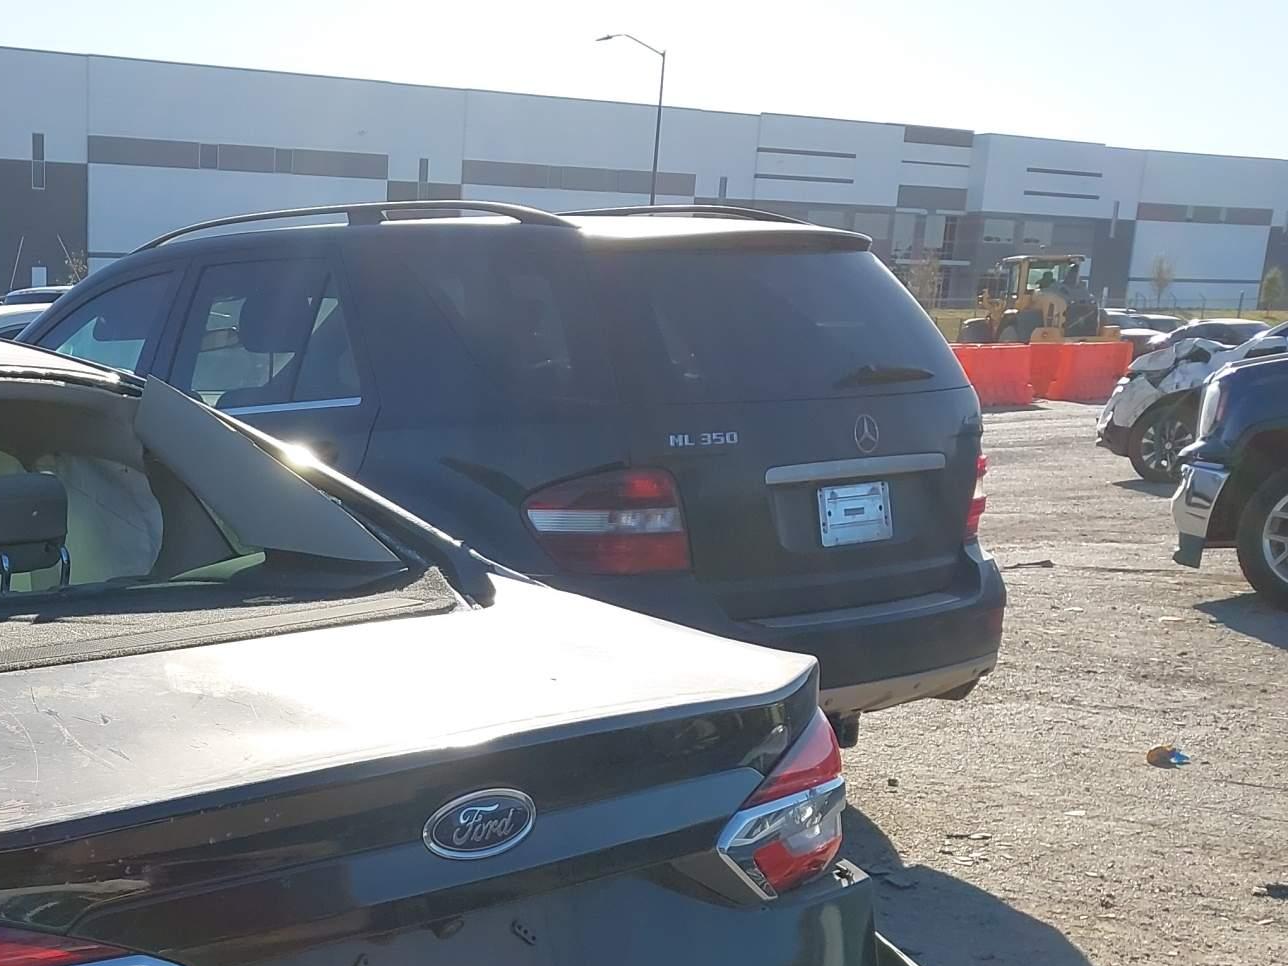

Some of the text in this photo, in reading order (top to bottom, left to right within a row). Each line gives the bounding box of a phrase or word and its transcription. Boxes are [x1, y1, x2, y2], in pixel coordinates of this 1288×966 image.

[669, 431, 738, 447] ML 350
[452, 803, 523, 846] Ford
